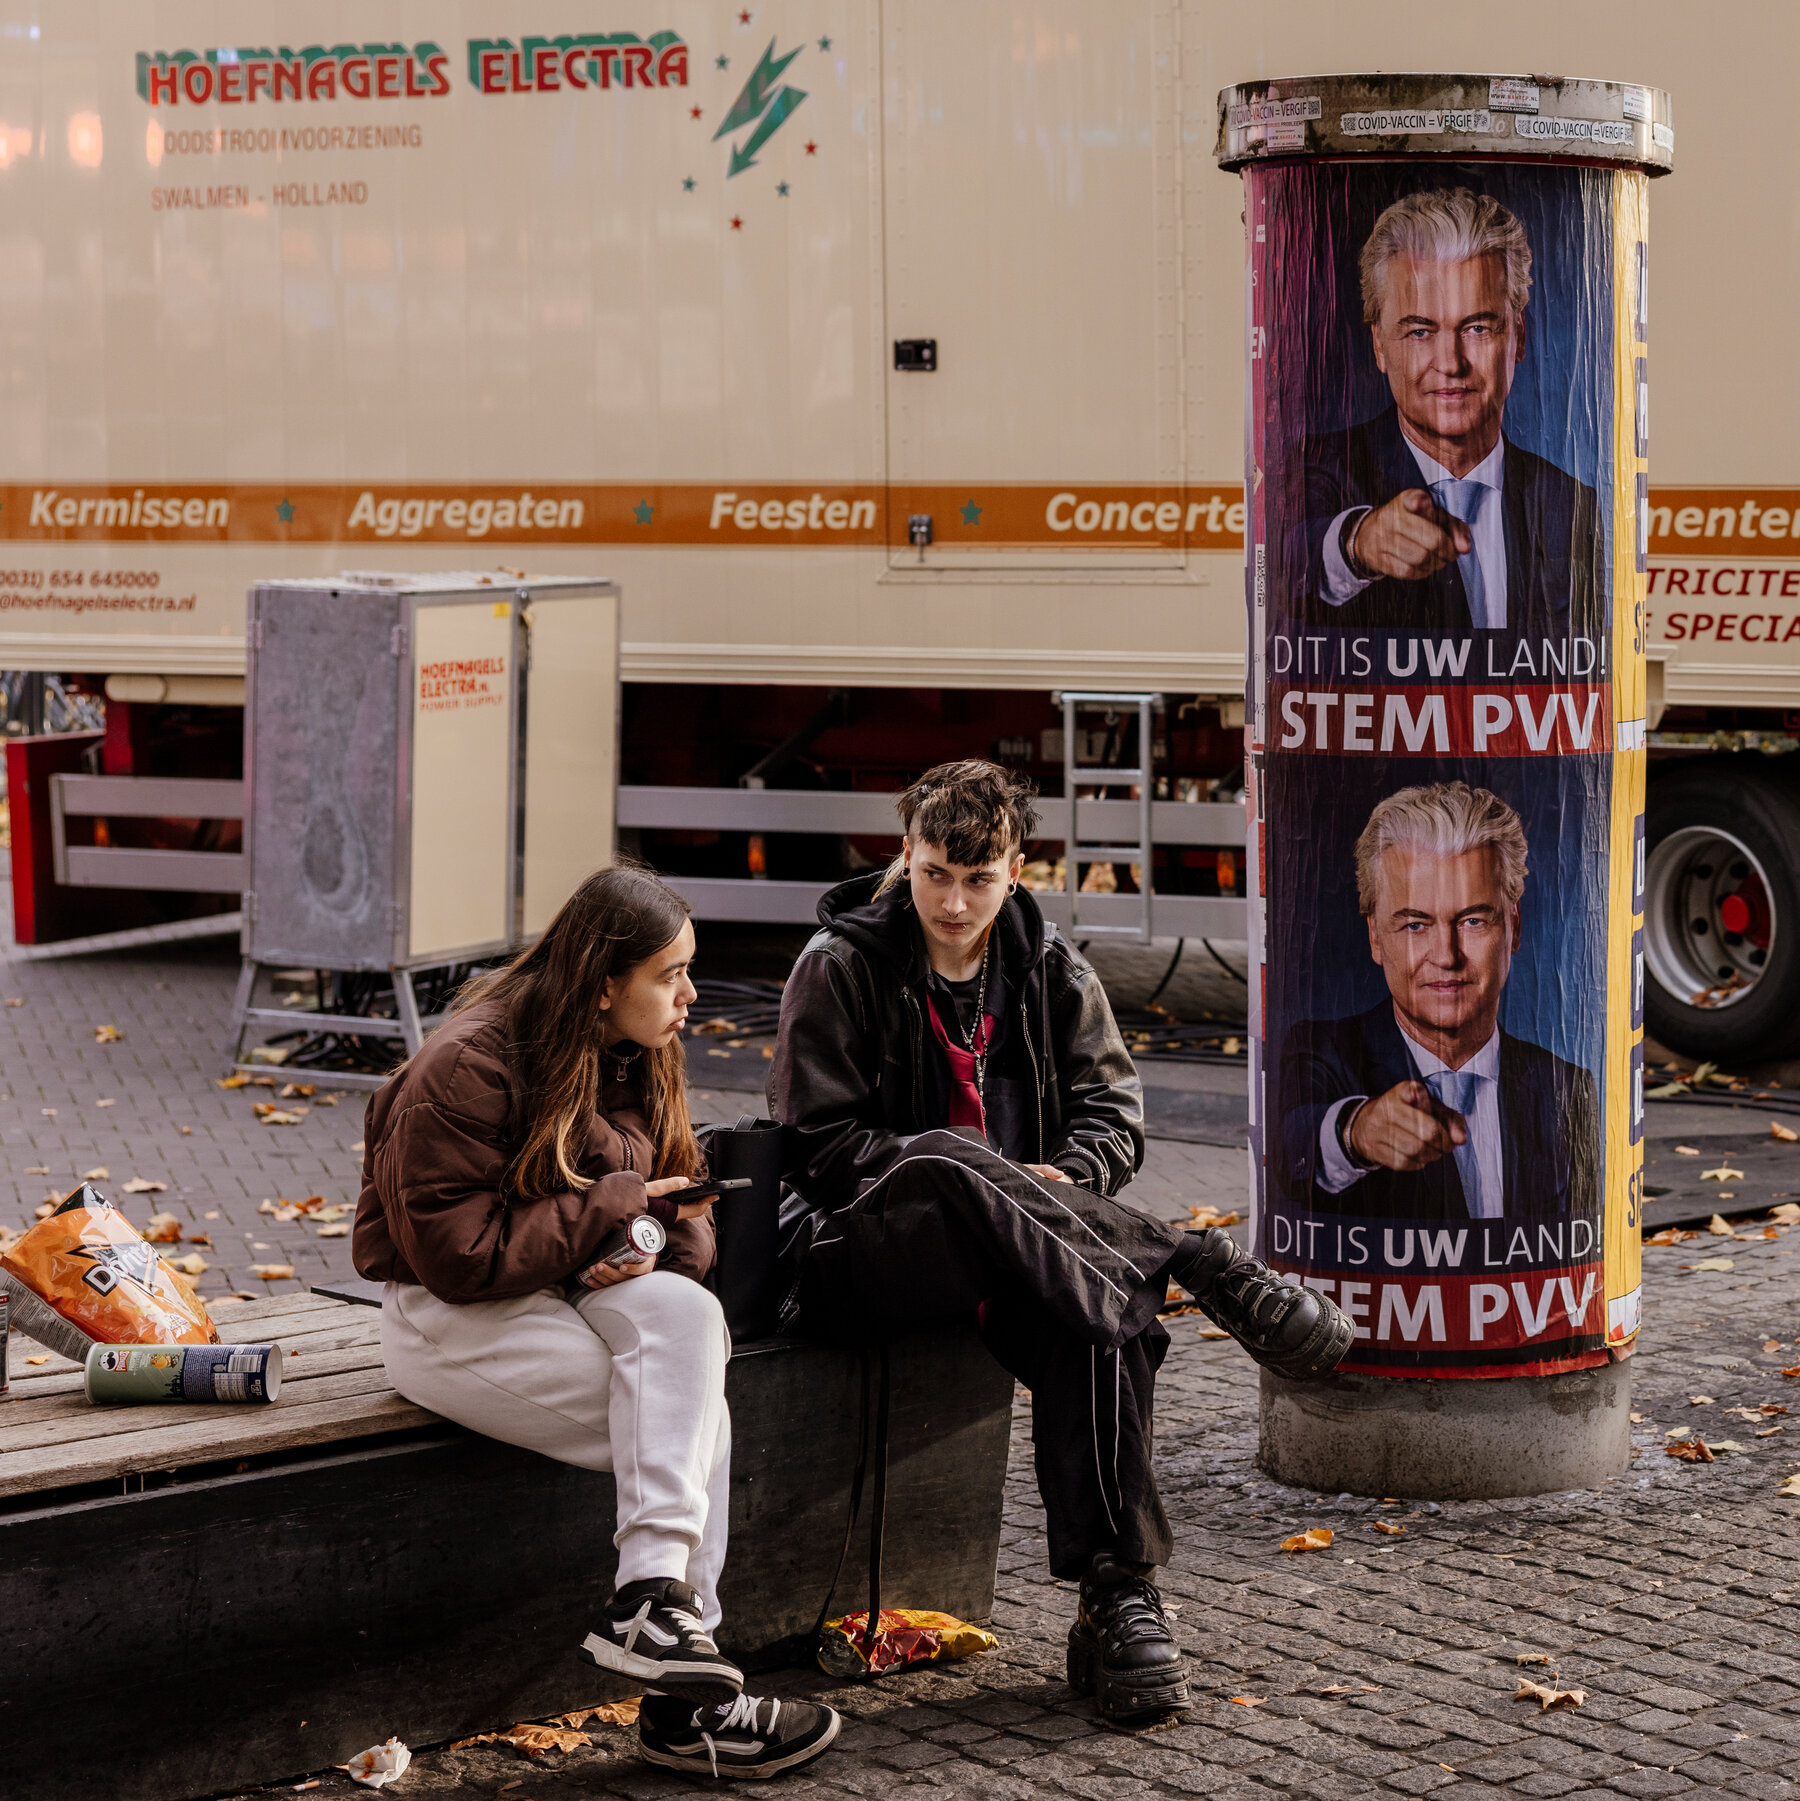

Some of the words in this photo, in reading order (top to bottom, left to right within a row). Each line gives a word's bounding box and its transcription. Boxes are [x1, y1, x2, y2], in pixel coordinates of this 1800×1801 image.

[147, 53, 452, 106] HOEFNAGELS
[480, 43, 689, 94] ELECTRA
[1281, 102, 1307, 117] VERGIF
[1357, 115, 1426, 130] COVID-VACCIN
[1437, 114, 1472, 129] VERGIF
[152, 124, 423, 155] OODSTROOMVOORZIENING
[1532, 120, 1593, 137] COVID-VACCIN
[1600, 125, 1624, 140] VERGIF
[151, 184, 249, 211] SWALMEN
[272, 180, 368, 207] HOLLAND
[29, 488, 230, 528] Kermissen
[347, 491, 585, 537] Aggregaten
[708, 491, 877, 530] Feesten
[1045, 492, 1245, 534] Concerte
[50, 571, 85, 587] 654
[90, 571, 160, 588] 645000
[420, 656, 504, 680] HOEFNAGELS
[1274, 635, 1327, 675] DIT
[1340, 637, 1372, 677] IS
[1387, 638, 1472, 678] UW
[1487, 635, 1606, 678] LAND!
[1280, 690, 1451, 752] STEM
[1472, 691, 1600, 752] PVV
[1273, 1214, 1325, 1261] DIT
[1337, 1224, 1370, 1265] IS
[1383, 1228, 1468, 1268] UW
[1483, 1214, 1602, 1267] LAND!
[1469, 1271, 1597, 1342] PVV
